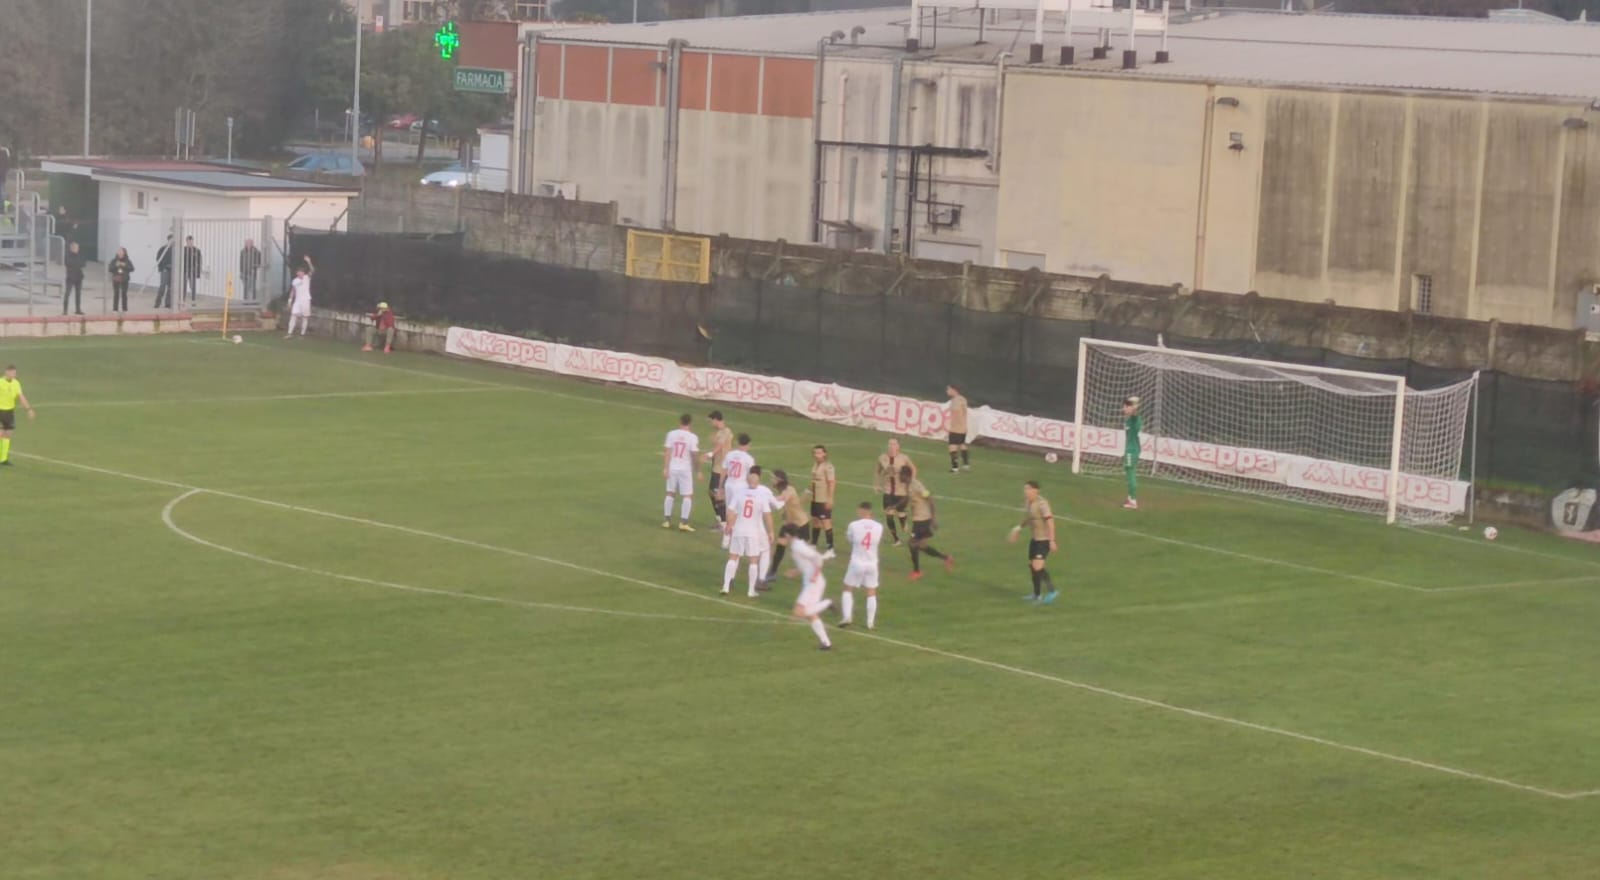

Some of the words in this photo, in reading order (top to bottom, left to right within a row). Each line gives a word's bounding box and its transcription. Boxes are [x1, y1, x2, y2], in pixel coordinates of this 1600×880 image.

[456, 71, 503, 89] FARMACIA
[480, 331, 548, 363] Kappa
[591, 350, 664, 381] Kappa
[705, 371, 782, 399] Kappa
[1024, 419, 1118, 449] Kappa
[673, 441, 687, 459] 17
[1179, 443, 1277, 474] Kappa
[743, 499, 754, 519] 6
[860, 531, 872, 552] 4
